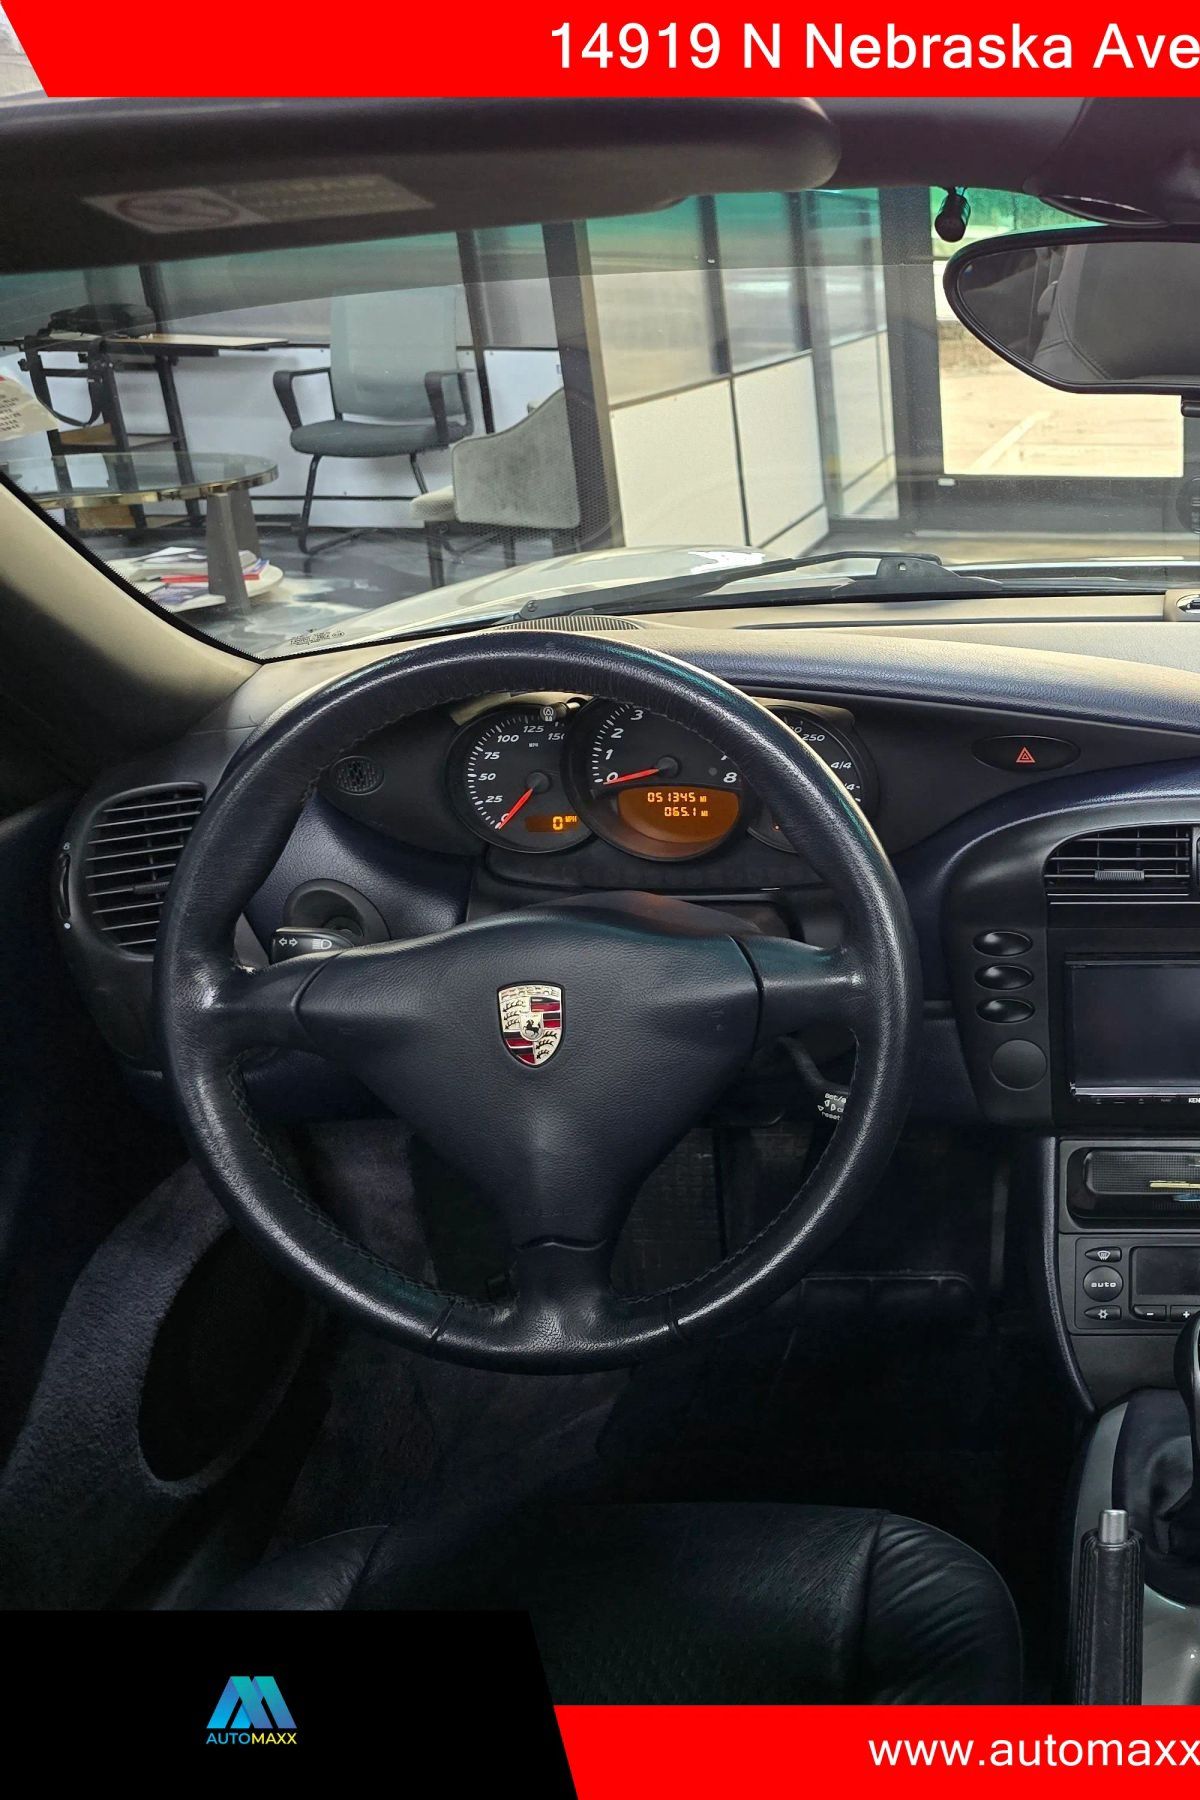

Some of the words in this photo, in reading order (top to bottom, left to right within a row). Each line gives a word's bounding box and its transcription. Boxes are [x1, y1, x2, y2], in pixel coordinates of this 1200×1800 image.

[630, 709, 643, 720] 3
[523, 725, 544, 733] 125
[611, 728, 624, 739] 2
[497, 735, 520, 743] 100
[802, 734, 825, 742] 250
[484, 752, 500, 760] 75
[605, 749, 613, 760] 1
[830, 761, 852, 769] 4/4
[478, 773, 496, 781] 50
[723, 772, 737, 783] 8
[485, 795, 503, 803] 25
[647, 792, 696, 803] 051345
[664, 806, 697, 817] 065.1
[553, 816, 564, 831] 0
